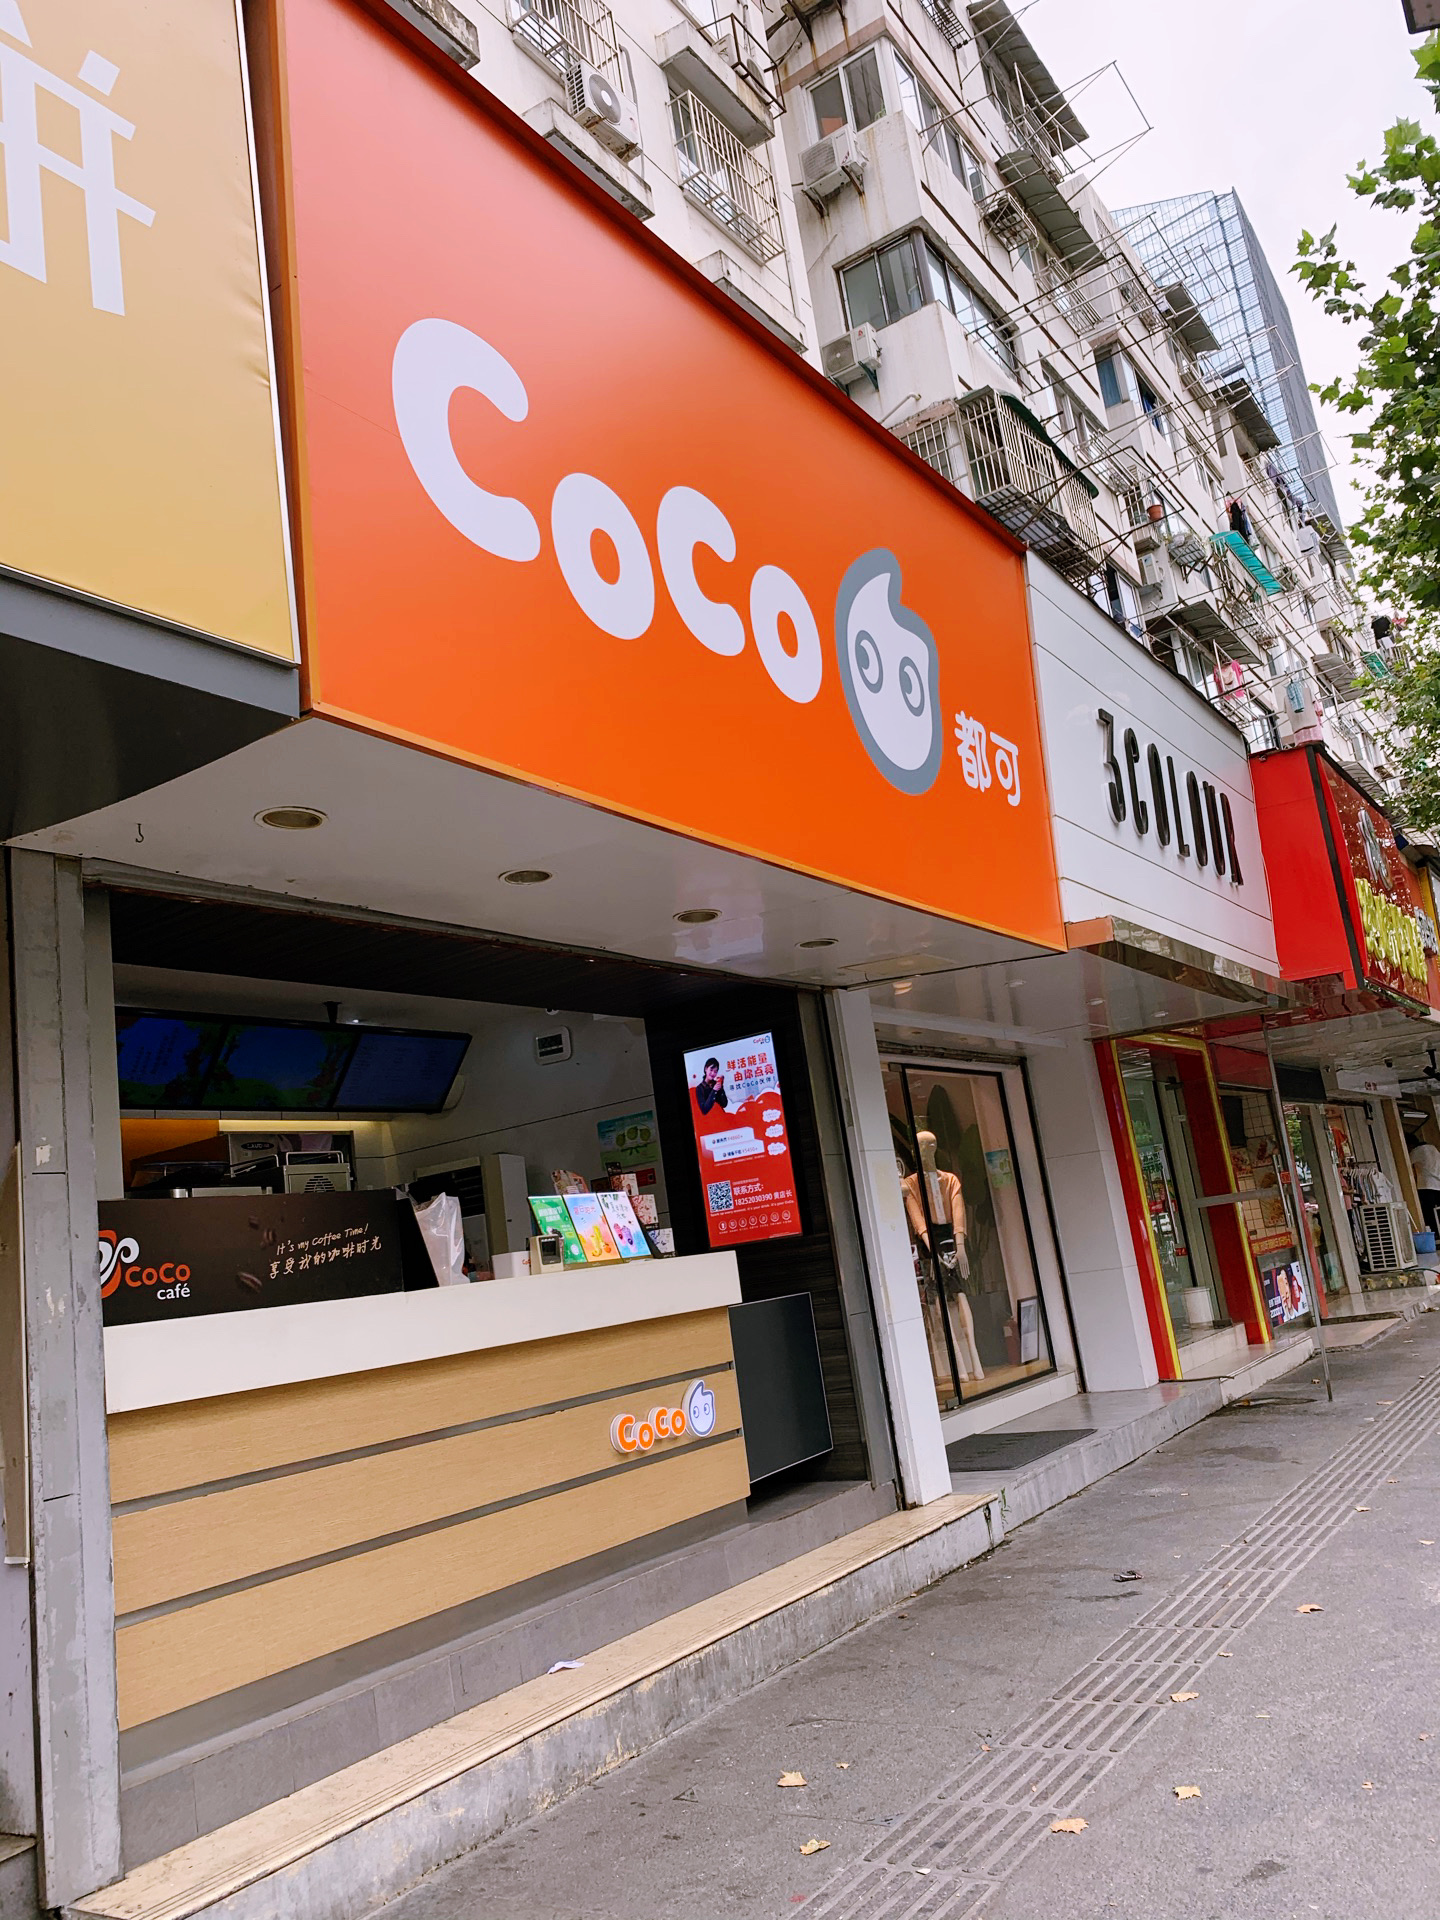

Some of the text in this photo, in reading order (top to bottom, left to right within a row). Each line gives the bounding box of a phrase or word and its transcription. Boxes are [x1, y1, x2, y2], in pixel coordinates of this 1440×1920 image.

[954, 711, 1021, 807] 都可
[1096, 708, 1244, 887] 3COLOUR
[727, 1052, 767, 1070] 鲜活能量
[734, 1064, 774, 1082] 由你点亮
[735, 1193, 772, 1206] 18252030390
[297, 1240, 310, 1252] my
[344, 1223, 369, 1238] Time!
[269, 1236, 382, 1280] 享受我的咖啡时光
[157, 1283, 191, 1301] café
